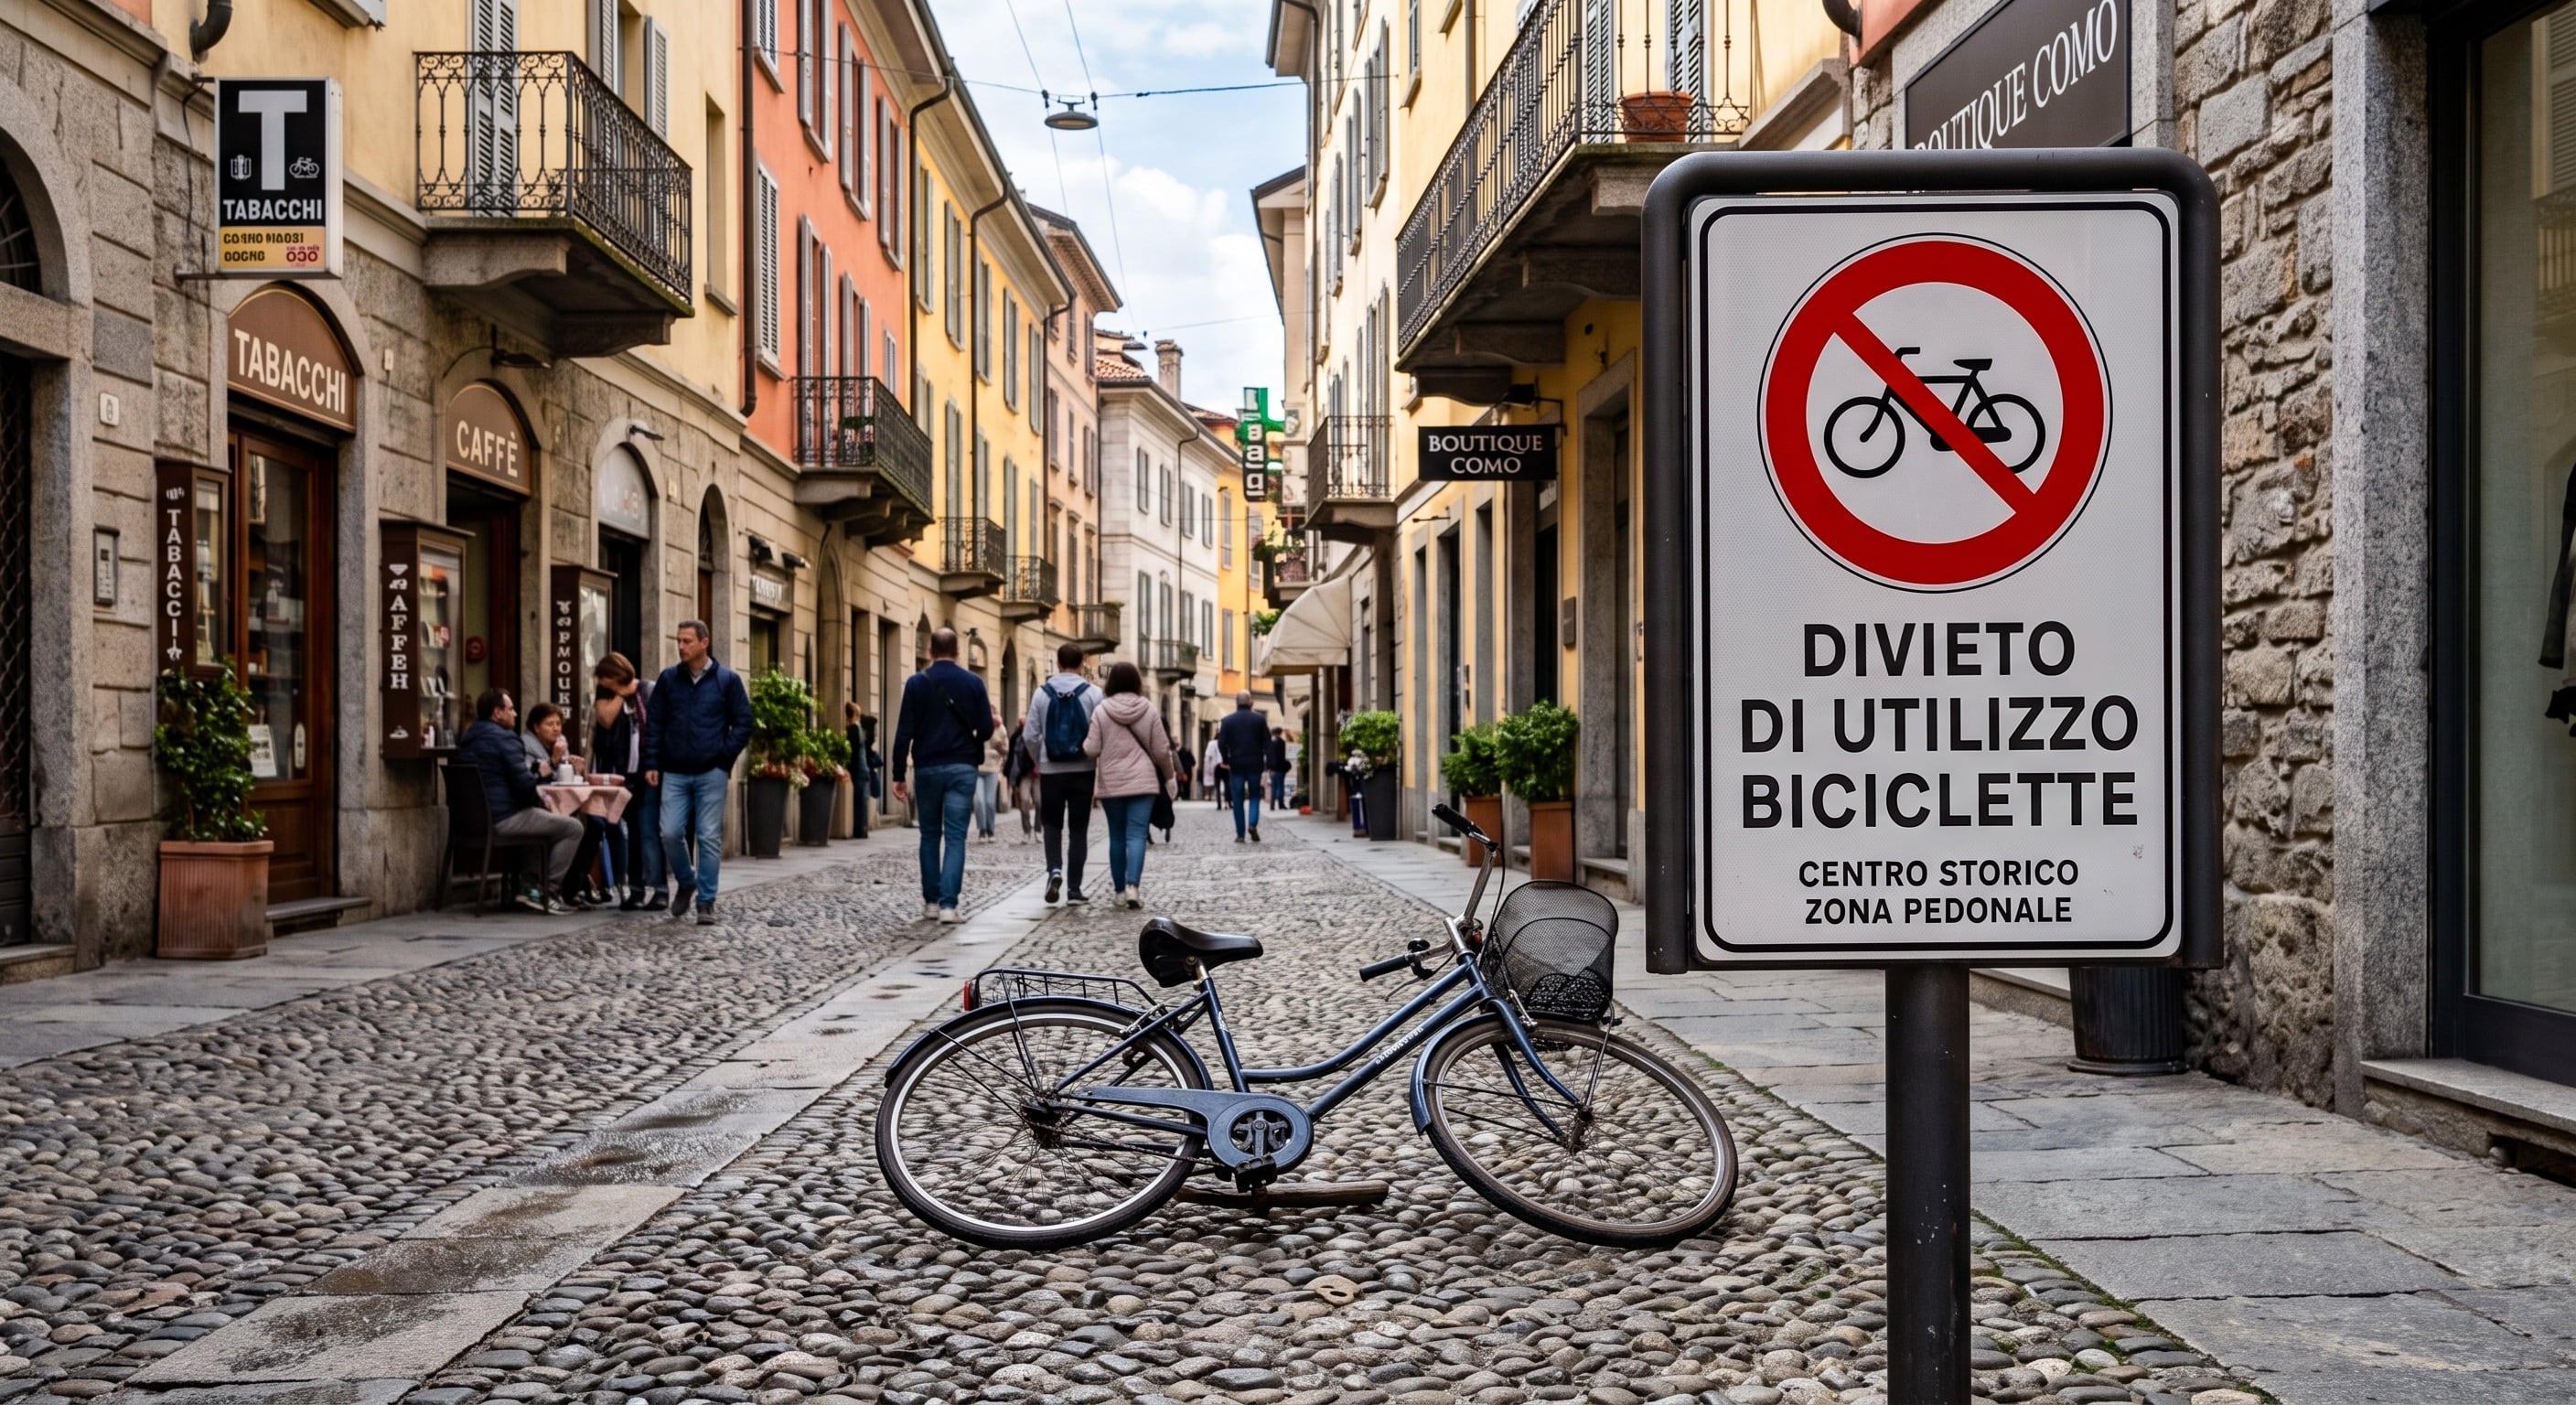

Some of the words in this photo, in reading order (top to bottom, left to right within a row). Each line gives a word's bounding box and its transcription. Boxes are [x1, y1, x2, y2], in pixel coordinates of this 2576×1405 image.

[1916, 61, 2027, 149] UTIQUE
[2033, 0, 2118, 108] COMO
[238, 90, 308, 190] T
[223, 198, 322, 220] TABACCHI
[234, 327, 347, 415] TABACCHI
[456, 419, 518, 478] CAFFÈ
[1428, 434, 1543, 455] BOUTIQUE
[1450, 456, 1521, 474] COMO
[1804, 620, 2076, 677] DIVIETO
[1741, 698, 1804, 753] DI
[1833, 694, 2139, 754] UTILIZZO
[1742, 771, 2138, 829] BICICLETTE
[1798, 860, 1928, 888] CENTRO
[1938, 859, 2079, 886] STORICO
[1805, 897, 1893, 925] ZONA
[1905, 896, 2072, 924] PEDONALE
